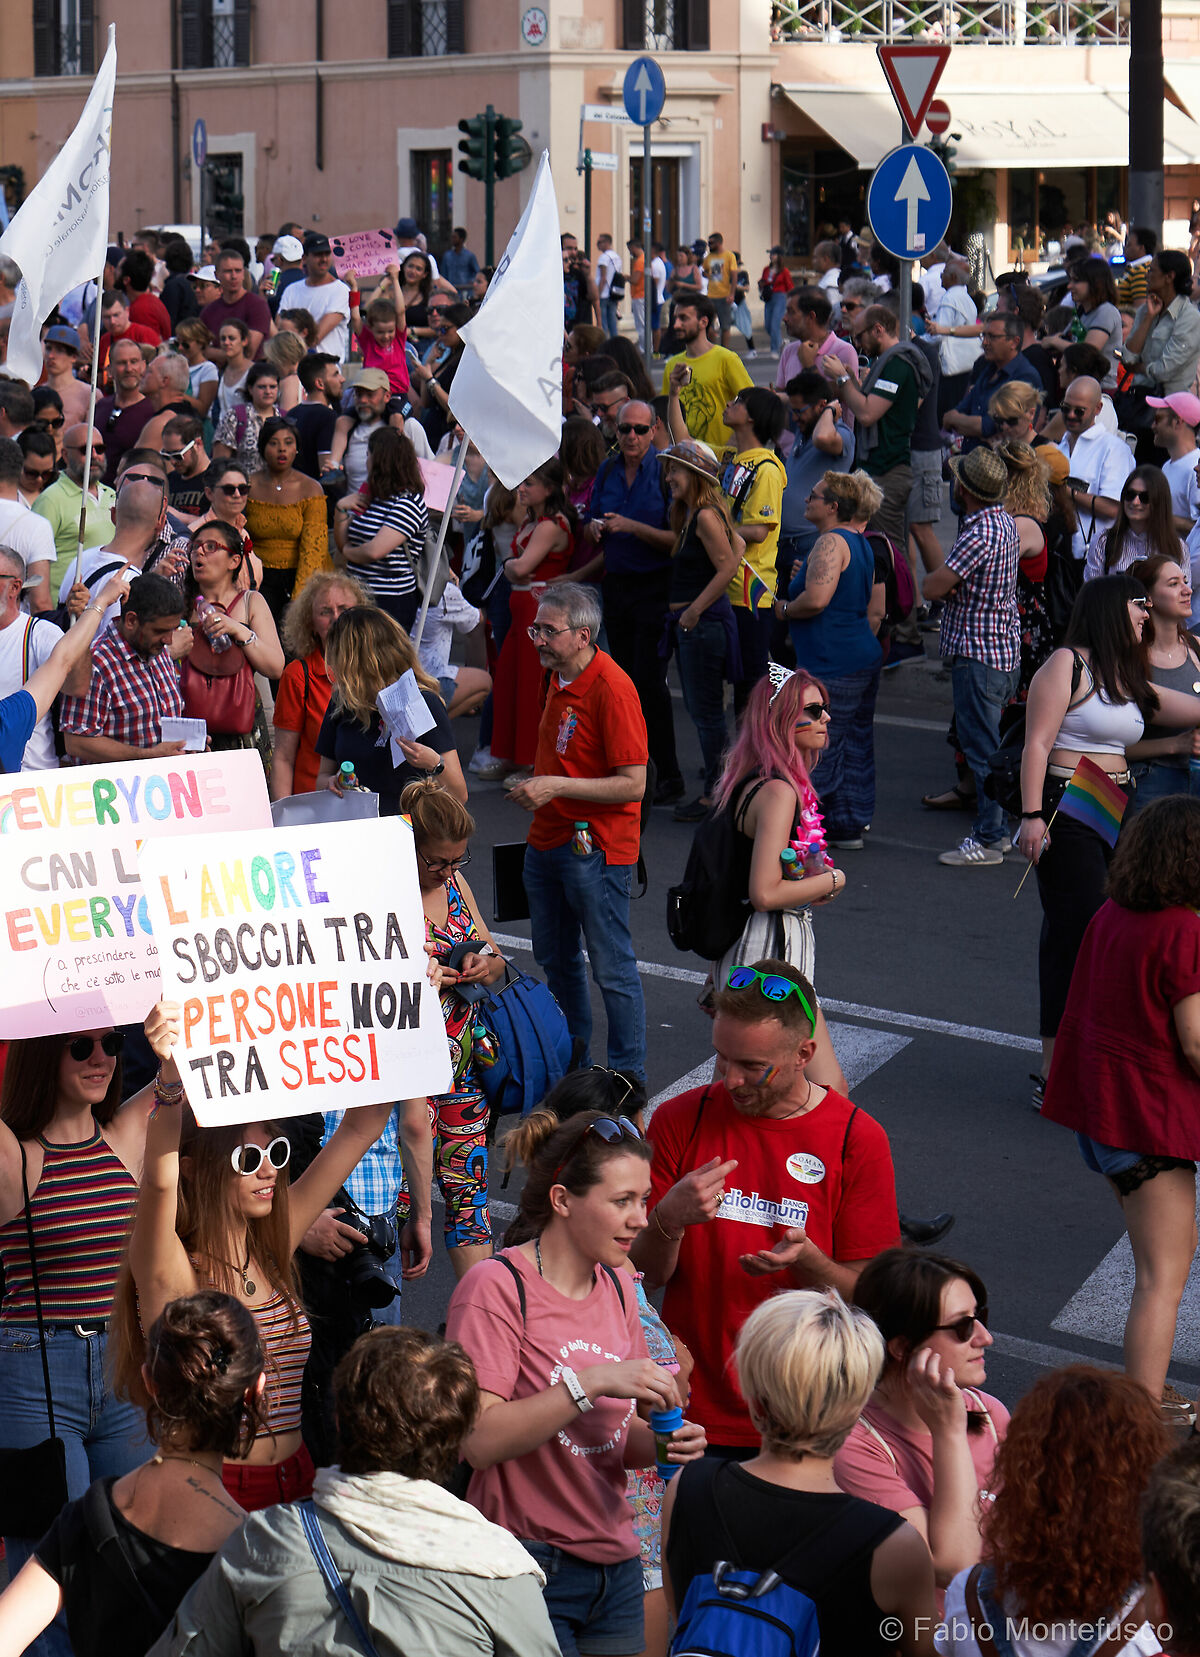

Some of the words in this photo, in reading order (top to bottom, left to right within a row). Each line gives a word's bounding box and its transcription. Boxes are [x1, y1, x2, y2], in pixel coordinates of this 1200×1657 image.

[956, 119, 1067, 138] ROYAL
[349, 233, 371, 244] LOVE
[349, 240, 381, 252] COMES
[11, 768, 231, 831] EVERYONE
[20, 851, 98, 891] CAN
[112, 848, 141, 884] L
[158, 848, 330, 925] L'AMORE
[5, 894, 154, 952] EVERYO
[74, 948, 137, 973] prescindere
[172, 919, 317, 984] SBOCCIA
[323, 912, 410, 962] TRA
[61, 977, 81, 993] che
[104, 971, 126, 986] sotto
[131, 969, 141, 981] le
[351, 981, 422, 1030] NON
[189, 1046, 270, 1100] TRA
[279, 1033, 380, 1091] SESSI
[792, 1154, 824, 1169] ROMAN
[723, 1188, 808, 1222] diolanum
[782, 1199, 809, 1210] BANCA
[567, 1339, 590, 1352] dolly
